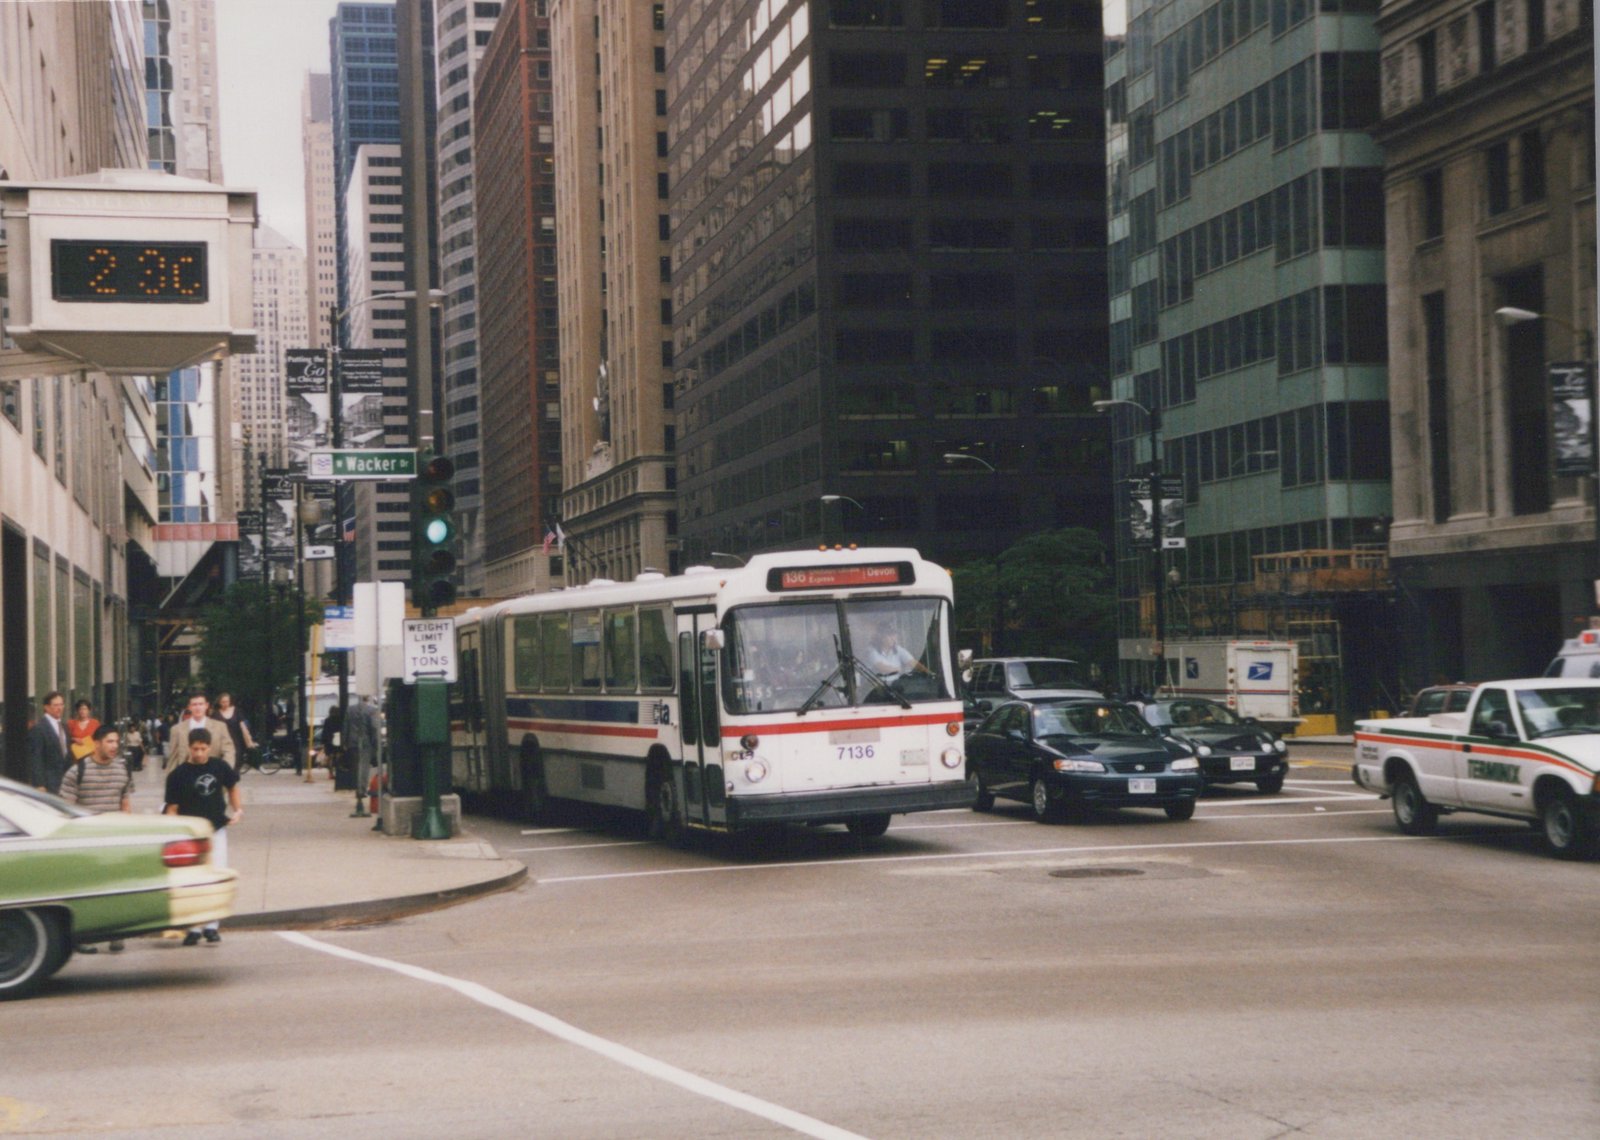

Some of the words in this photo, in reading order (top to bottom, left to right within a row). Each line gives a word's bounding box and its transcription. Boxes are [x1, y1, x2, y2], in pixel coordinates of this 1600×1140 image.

[287, 355, 313, 364] Putting
[313, 354, 326, 363] the
[304, 363, 326, 378] Go
[297, 376, 326, 385] Chicago
[336, 460, 344, 468] W
[346, 456, 397, 471] Wacker
[400, 460, 410, 468] Dr
[785, 571, 806, 584] 136
[866, 566, 897, 578] Devon
[808, 574, 835, 584] Express
[407, 622, 450, 632] WEIGHT
[414, 633, 444, 642] LIMIT
[421, 644, 438, 655] 15
[411, 655, 449, 667] TONS
[837, 744, 875, 760] 7136
